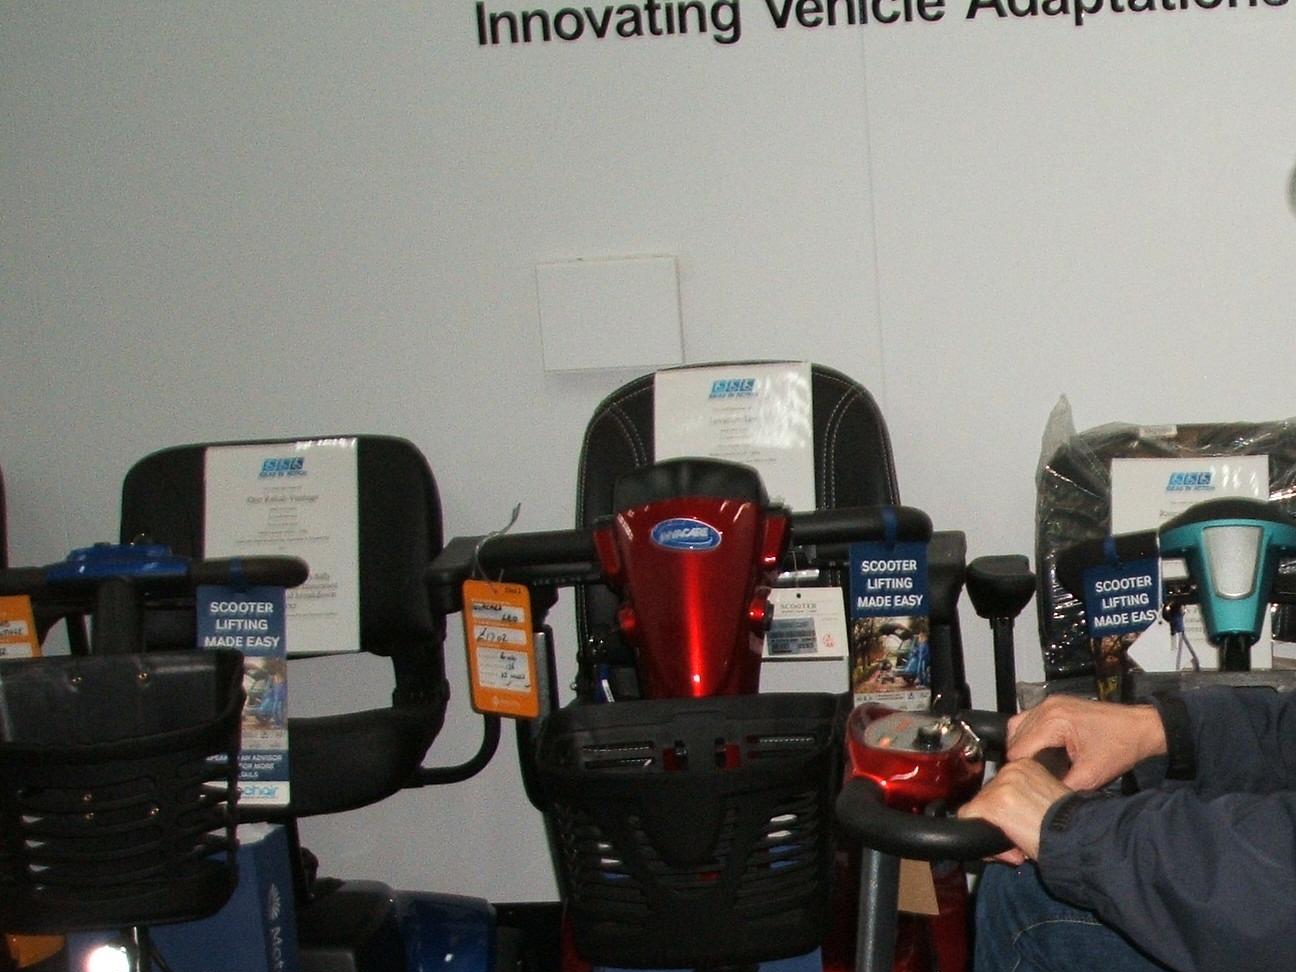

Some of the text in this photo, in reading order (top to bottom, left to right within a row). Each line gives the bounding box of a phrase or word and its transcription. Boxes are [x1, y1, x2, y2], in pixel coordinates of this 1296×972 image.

[477, 0, 742, 45] Innovating
[861, 559, 917, 572] SCOOTER
[867, 577, 913, 590] LIFTING
[1095, 575, 1152, 592] SCOOTER
[210, 601, 274, 613] SCOOTER
[857, 594, 923, 607] MADE EASY
[1102, 593, 1150, 609] LIFTING
[216, 619, 268, 630] LIFTING
[1093, 612, 1130, 628] MADE
[204, 636, 280, 648] MADE EASY
